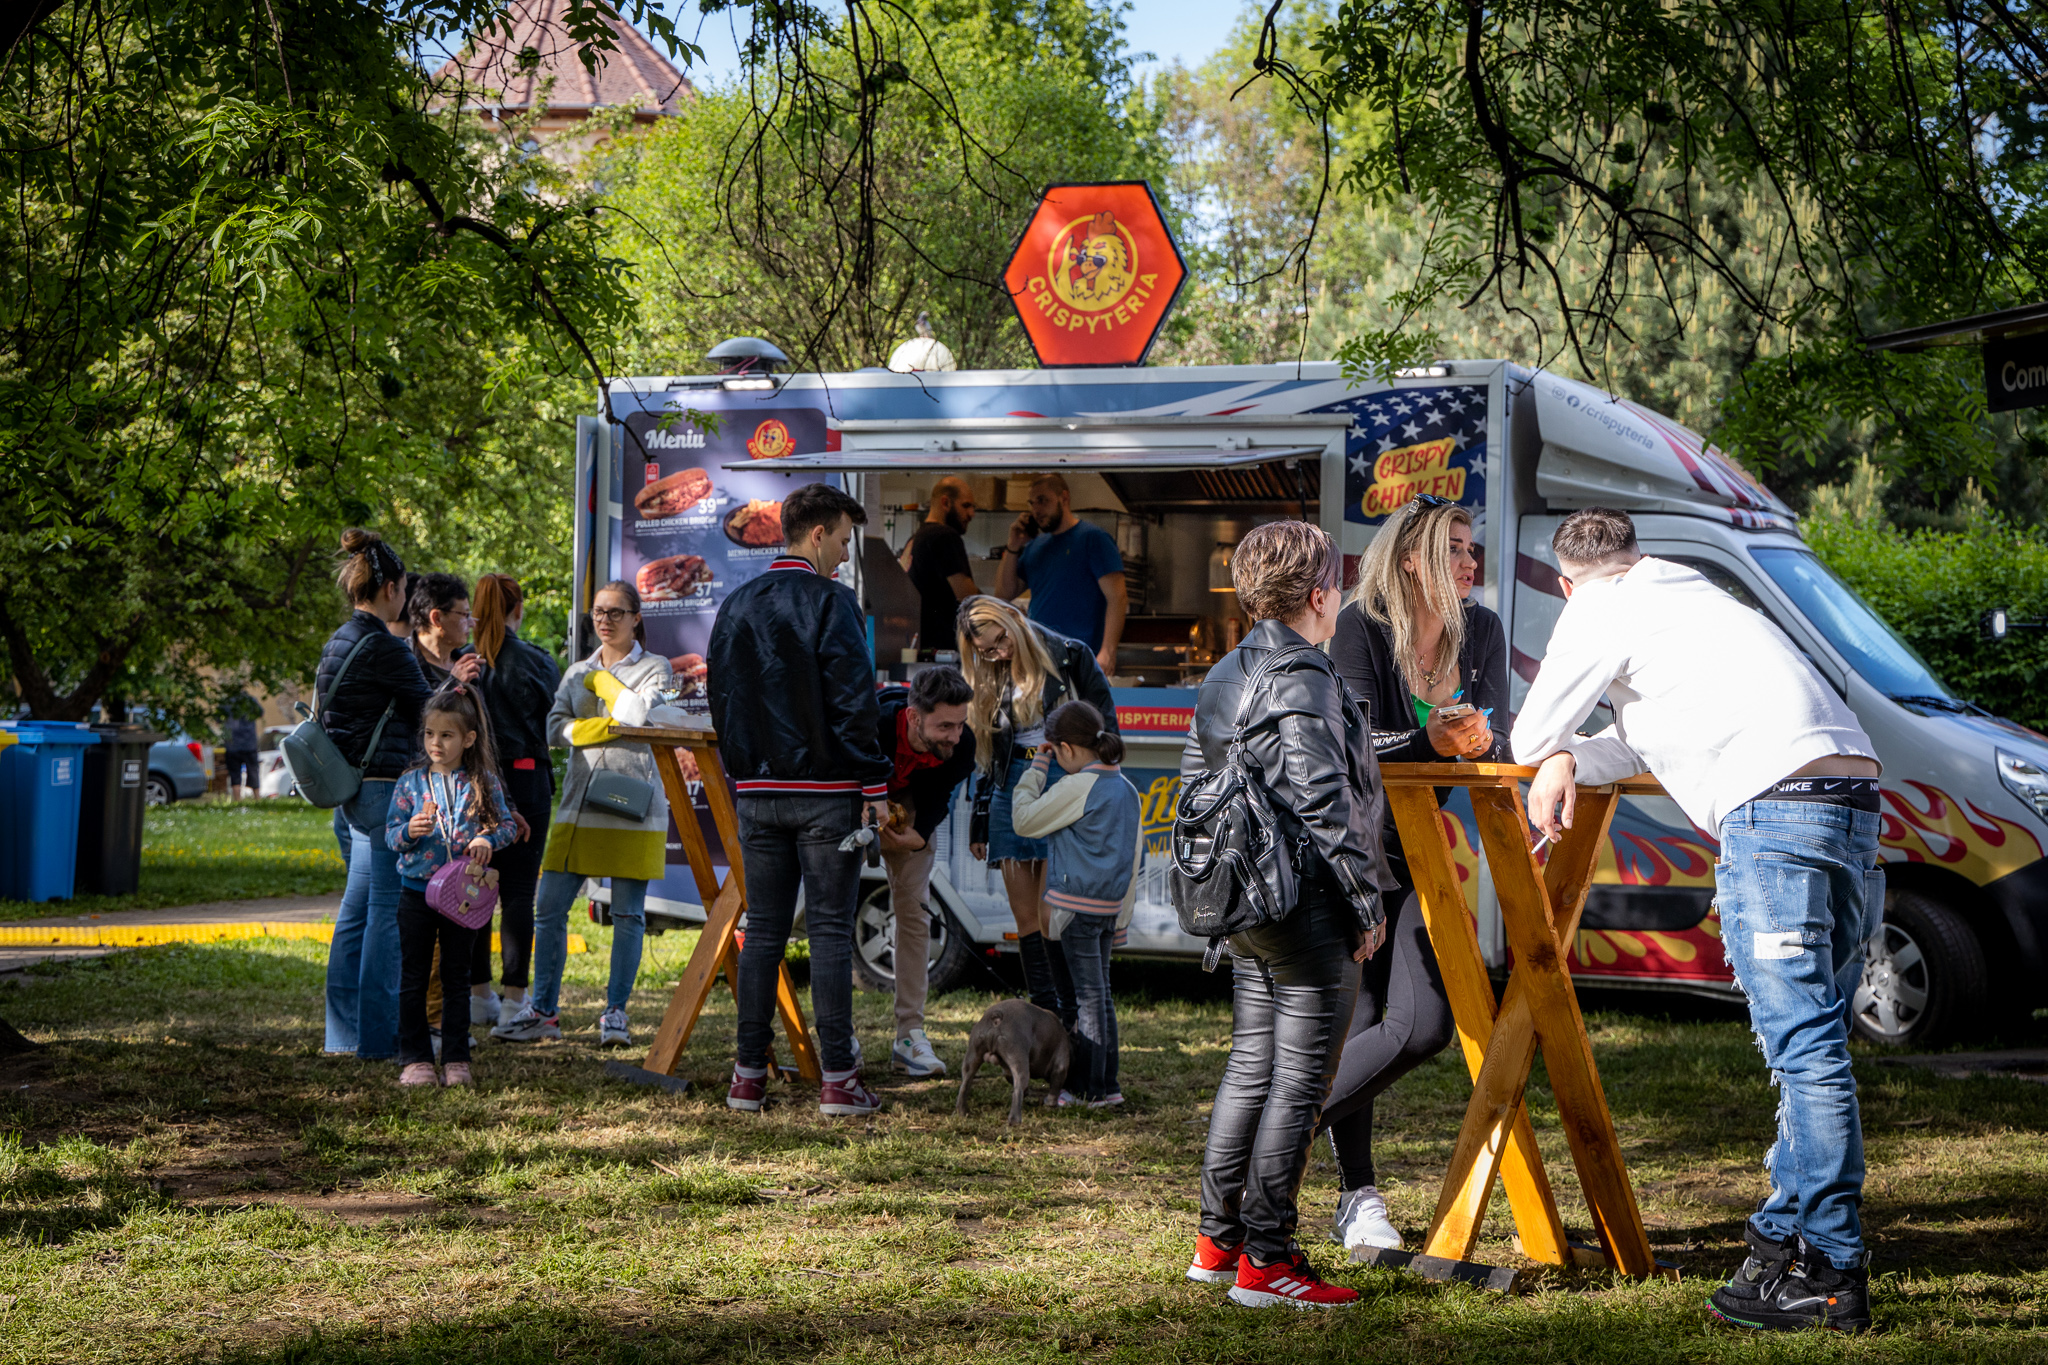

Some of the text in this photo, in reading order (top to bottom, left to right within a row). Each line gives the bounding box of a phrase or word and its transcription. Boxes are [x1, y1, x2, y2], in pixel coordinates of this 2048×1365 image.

[1028, 273, 1159, 334] CRISPYTERIA
[2001, 360, 2048, 392] Com
[644, 428, 706, 449] Meniu
[1379, 443, 1451, 479] CRISPY
[1367, 472, 1461, 512] CHICKEN
[698, 498, 717, 515] 39
[661, 517, 689, 527] CHICKEN
[695, 581, 712, 597] 37
[640, 600, 660, 610] RISPY
[1116, 712, 1192, 727] ISPYTERIA
[1772, 781, 1813, 792] NIKE
